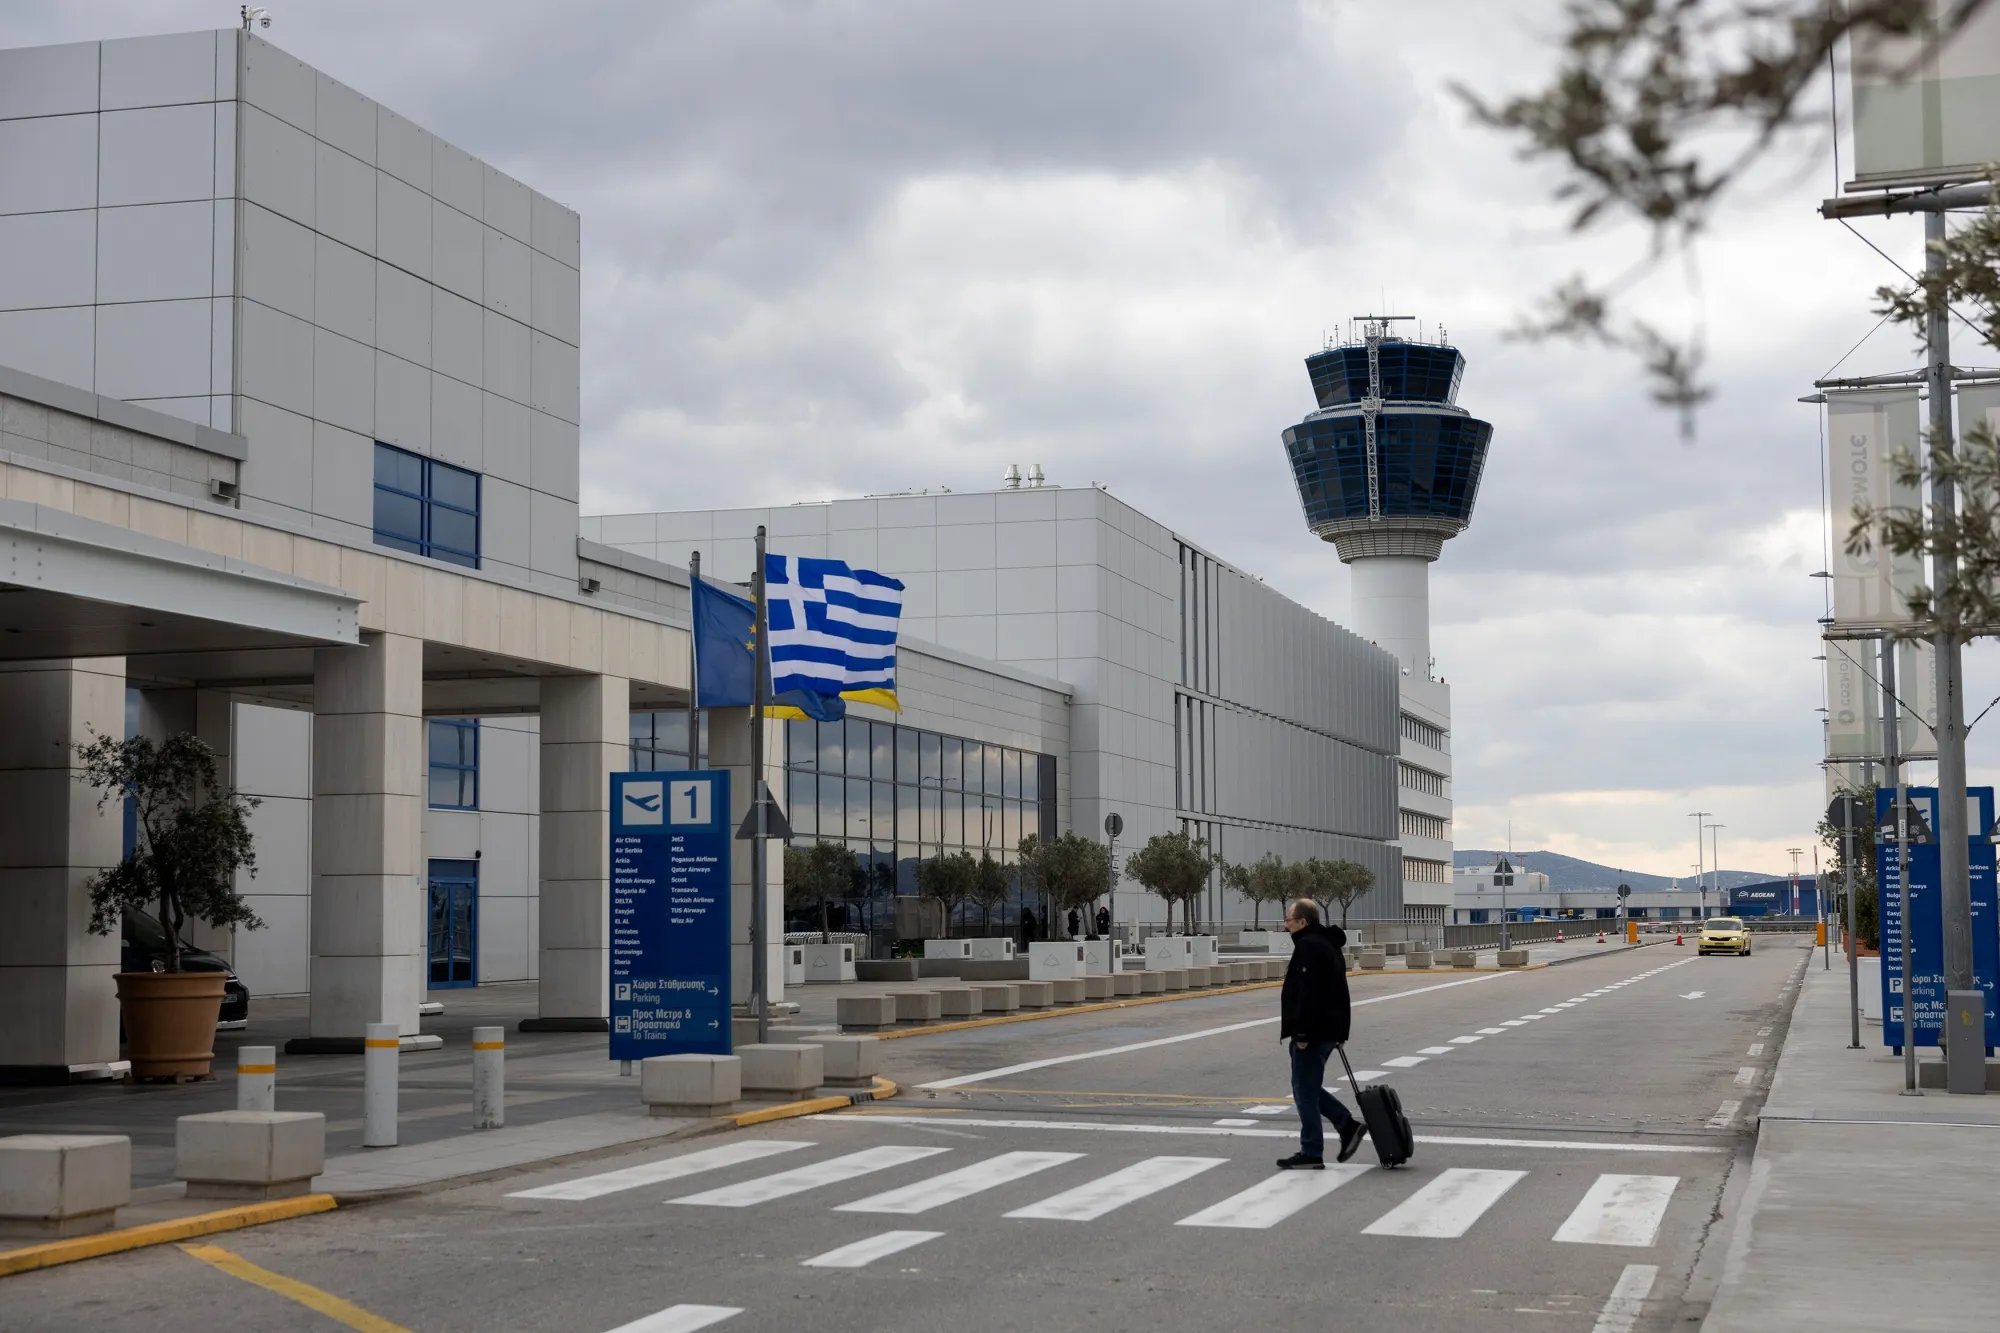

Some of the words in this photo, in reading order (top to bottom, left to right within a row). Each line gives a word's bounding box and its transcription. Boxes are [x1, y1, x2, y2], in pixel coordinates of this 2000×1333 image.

[684, 785, 697, 819] 1
[632, 979, 657, 991] Χώροι
[659, 979, 705, 991] Στάθμευσης
[1912, 974, 1931, 984] ώροι
[618, 985, 627, 999] P
[1911, 986, 1935, 997] arking
[632, 992, 660, 1004] Parking
[632, 1009, 653, 1020] Προς
[685, 1008, 692, 1018] &
[632, 1019, 681, 1031] Προαστιακό
[1919, 1020, 1943, 1028] Trains
[632, 1030, 642, 1040] To
[643, 1029, 667, 1040] Trains
